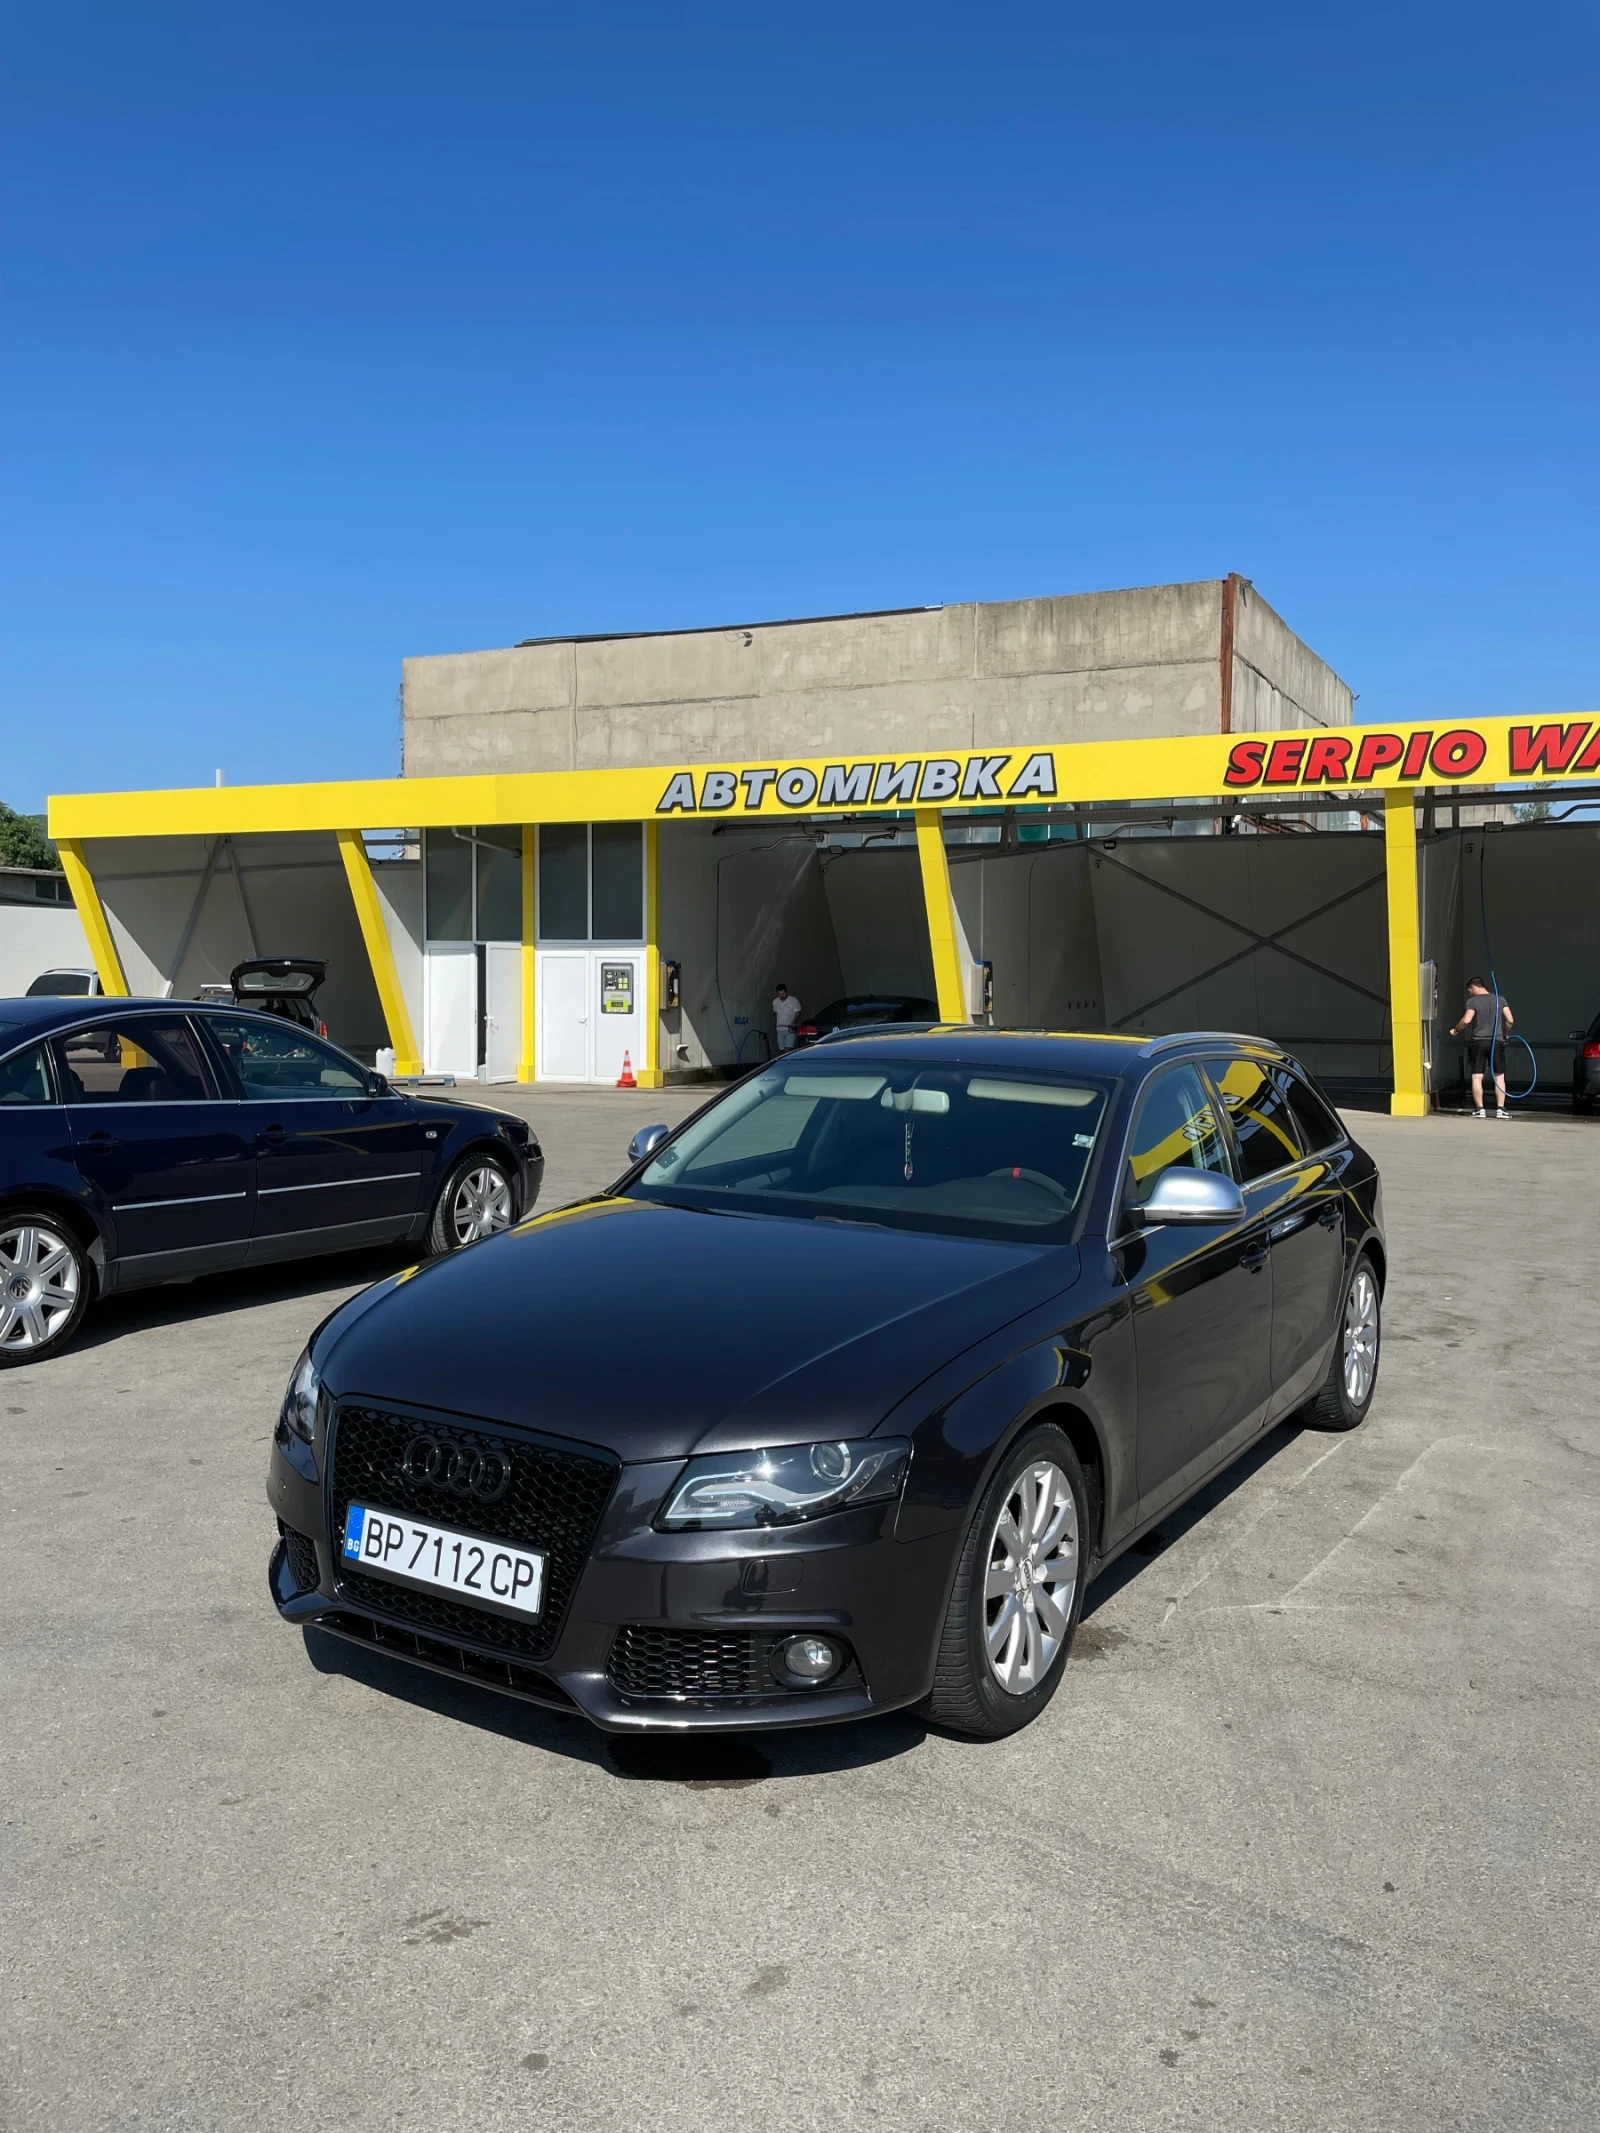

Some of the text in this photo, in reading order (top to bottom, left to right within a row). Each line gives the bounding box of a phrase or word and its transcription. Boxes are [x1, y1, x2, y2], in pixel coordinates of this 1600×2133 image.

[656, 753, 1057, 813] АВТОМИВКА
[1223, 729, 1487, 787] SERPIO
[347, 1538, 360, 1553] BG
[408, 1529, 485, 1590] 7112
